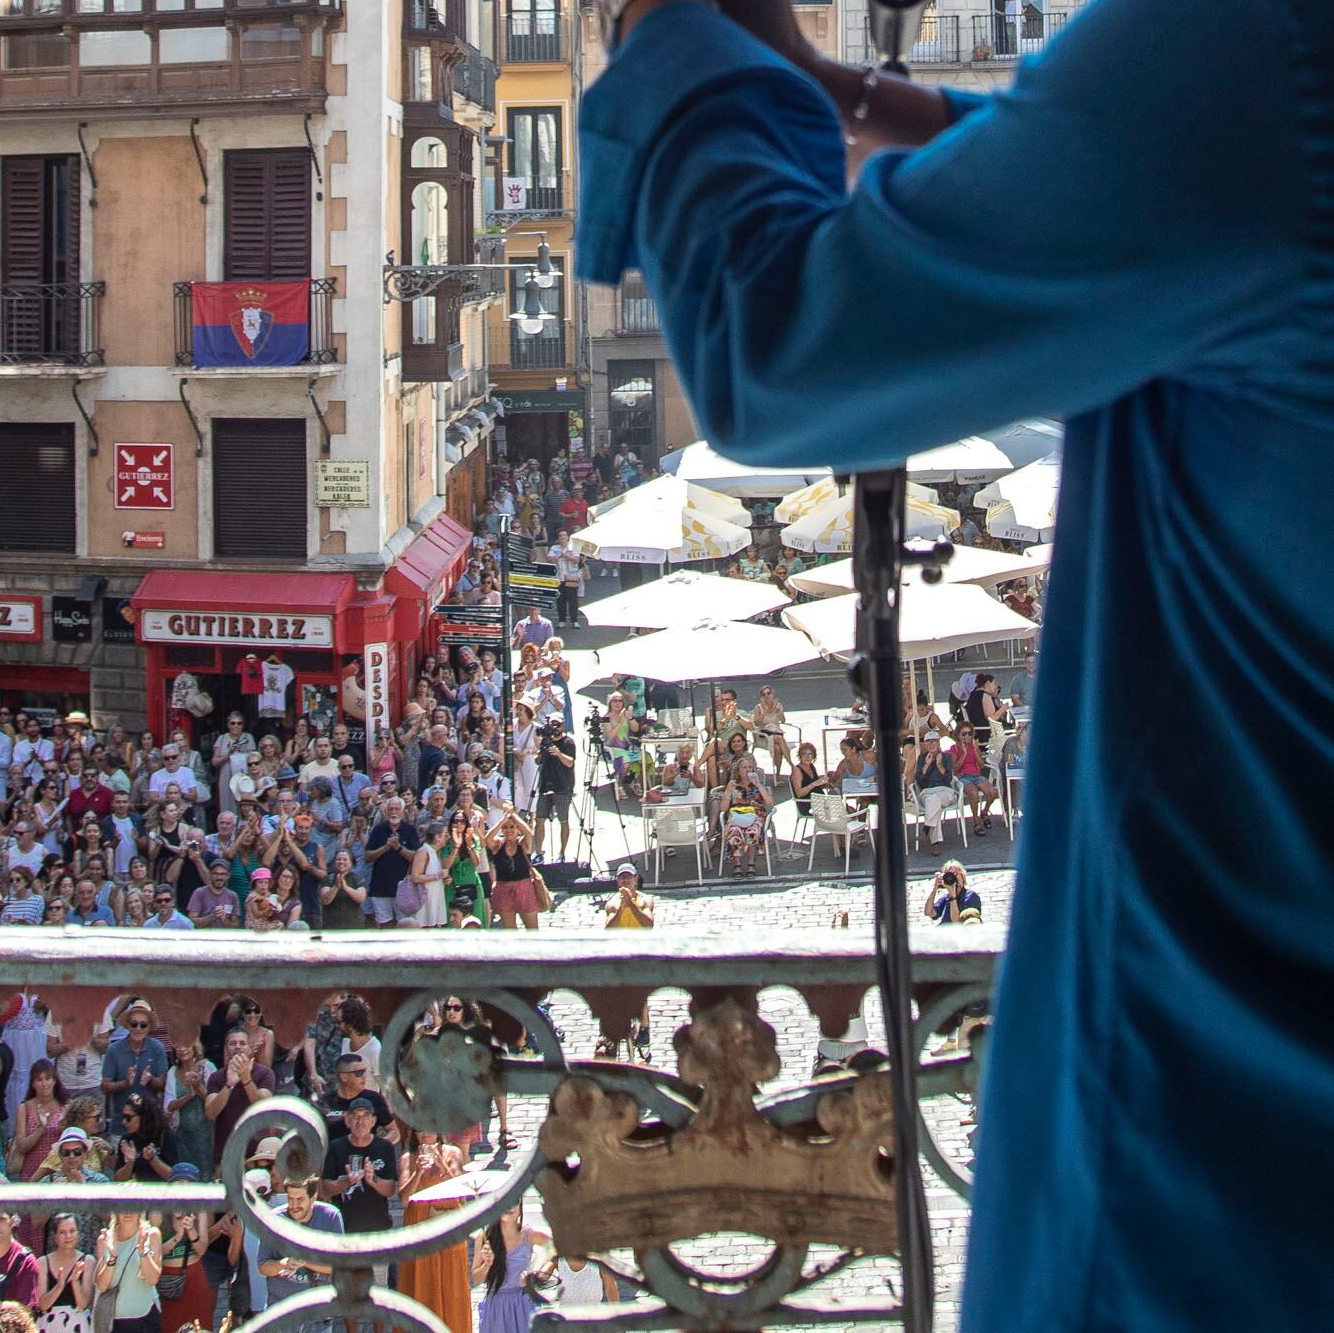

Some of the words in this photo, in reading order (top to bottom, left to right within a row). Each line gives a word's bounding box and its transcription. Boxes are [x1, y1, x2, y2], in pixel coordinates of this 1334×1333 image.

[119, 471, 169, 481] GUTIERREZ
[136, 534, 164, 543] Encierro
[620, 553, 646, 561] BLISS
[168, 614, 307, 640] GUTIERREZ
